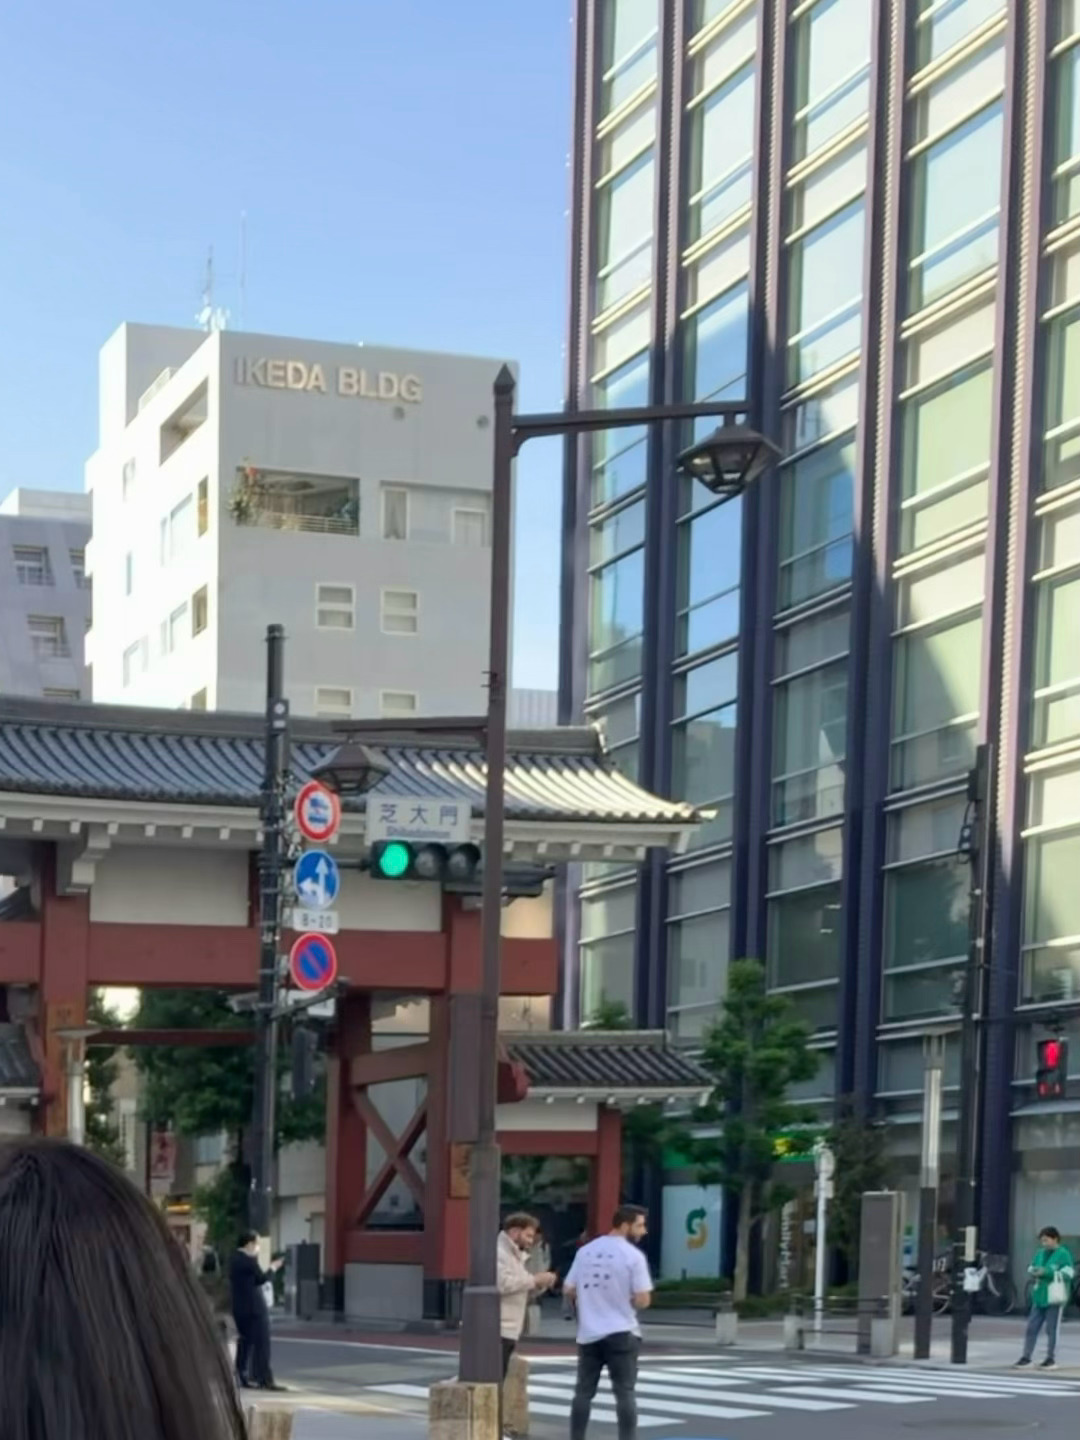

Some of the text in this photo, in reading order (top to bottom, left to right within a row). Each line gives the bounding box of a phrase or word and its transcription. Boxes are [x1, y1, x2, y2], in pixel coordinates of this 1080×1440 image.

[234, 357, 422, 402] IKEDA BLDG
[379, 803, 458, 826] 芝大門
